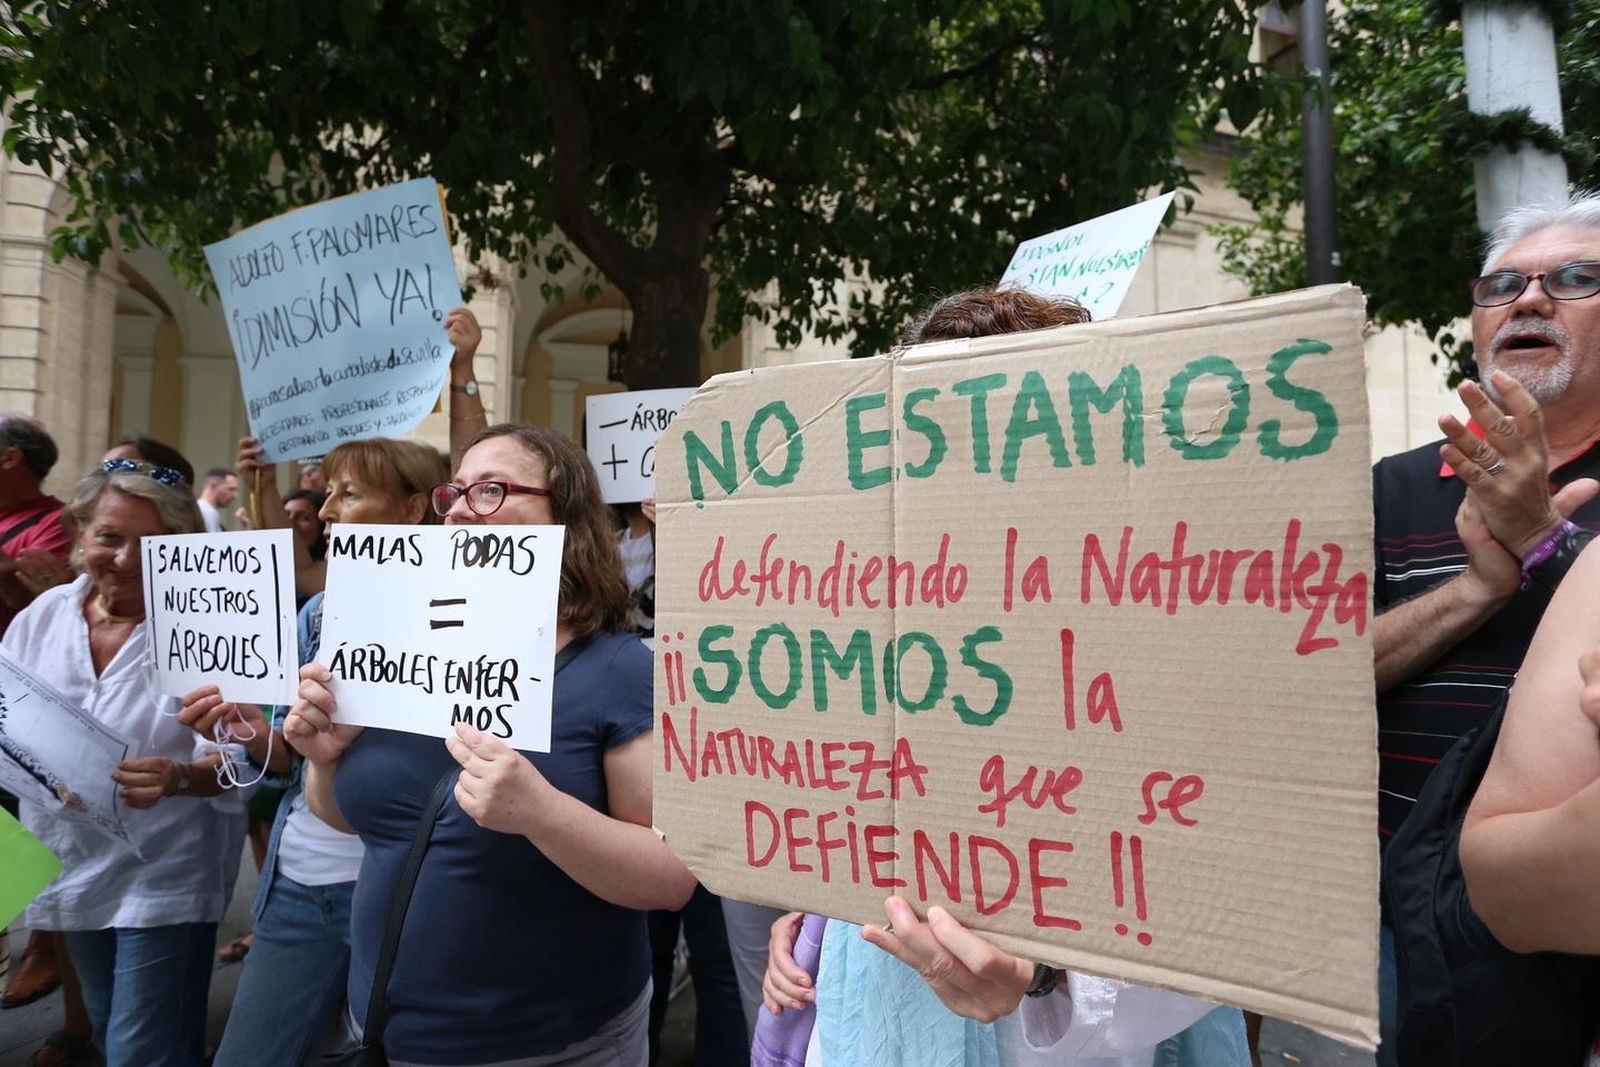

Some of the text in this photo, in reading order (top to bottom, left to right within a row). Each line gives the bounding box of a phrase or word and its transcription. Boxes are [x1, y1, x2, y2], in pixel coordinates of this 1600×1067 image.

[230, 242, 285, 295] ADOLFO
[1023, 256, 1077, 288] STAN
[682, 337, 1339, 510] NO ESTAMOS
[333, 529, 538, 576] MALAS PODAS
[165, 586, 259, 615] NUESTROS
[698, 518, 1368, 656] defendiendo la Naturaleza
[329, 642, 437, 694] ÁRBOLES
[1060, 628, 1123, 732] la
[450, 704, 513, 738] MOS
[978, 754, 1083, 828] que
[1137, 770, 1205, 827] se
